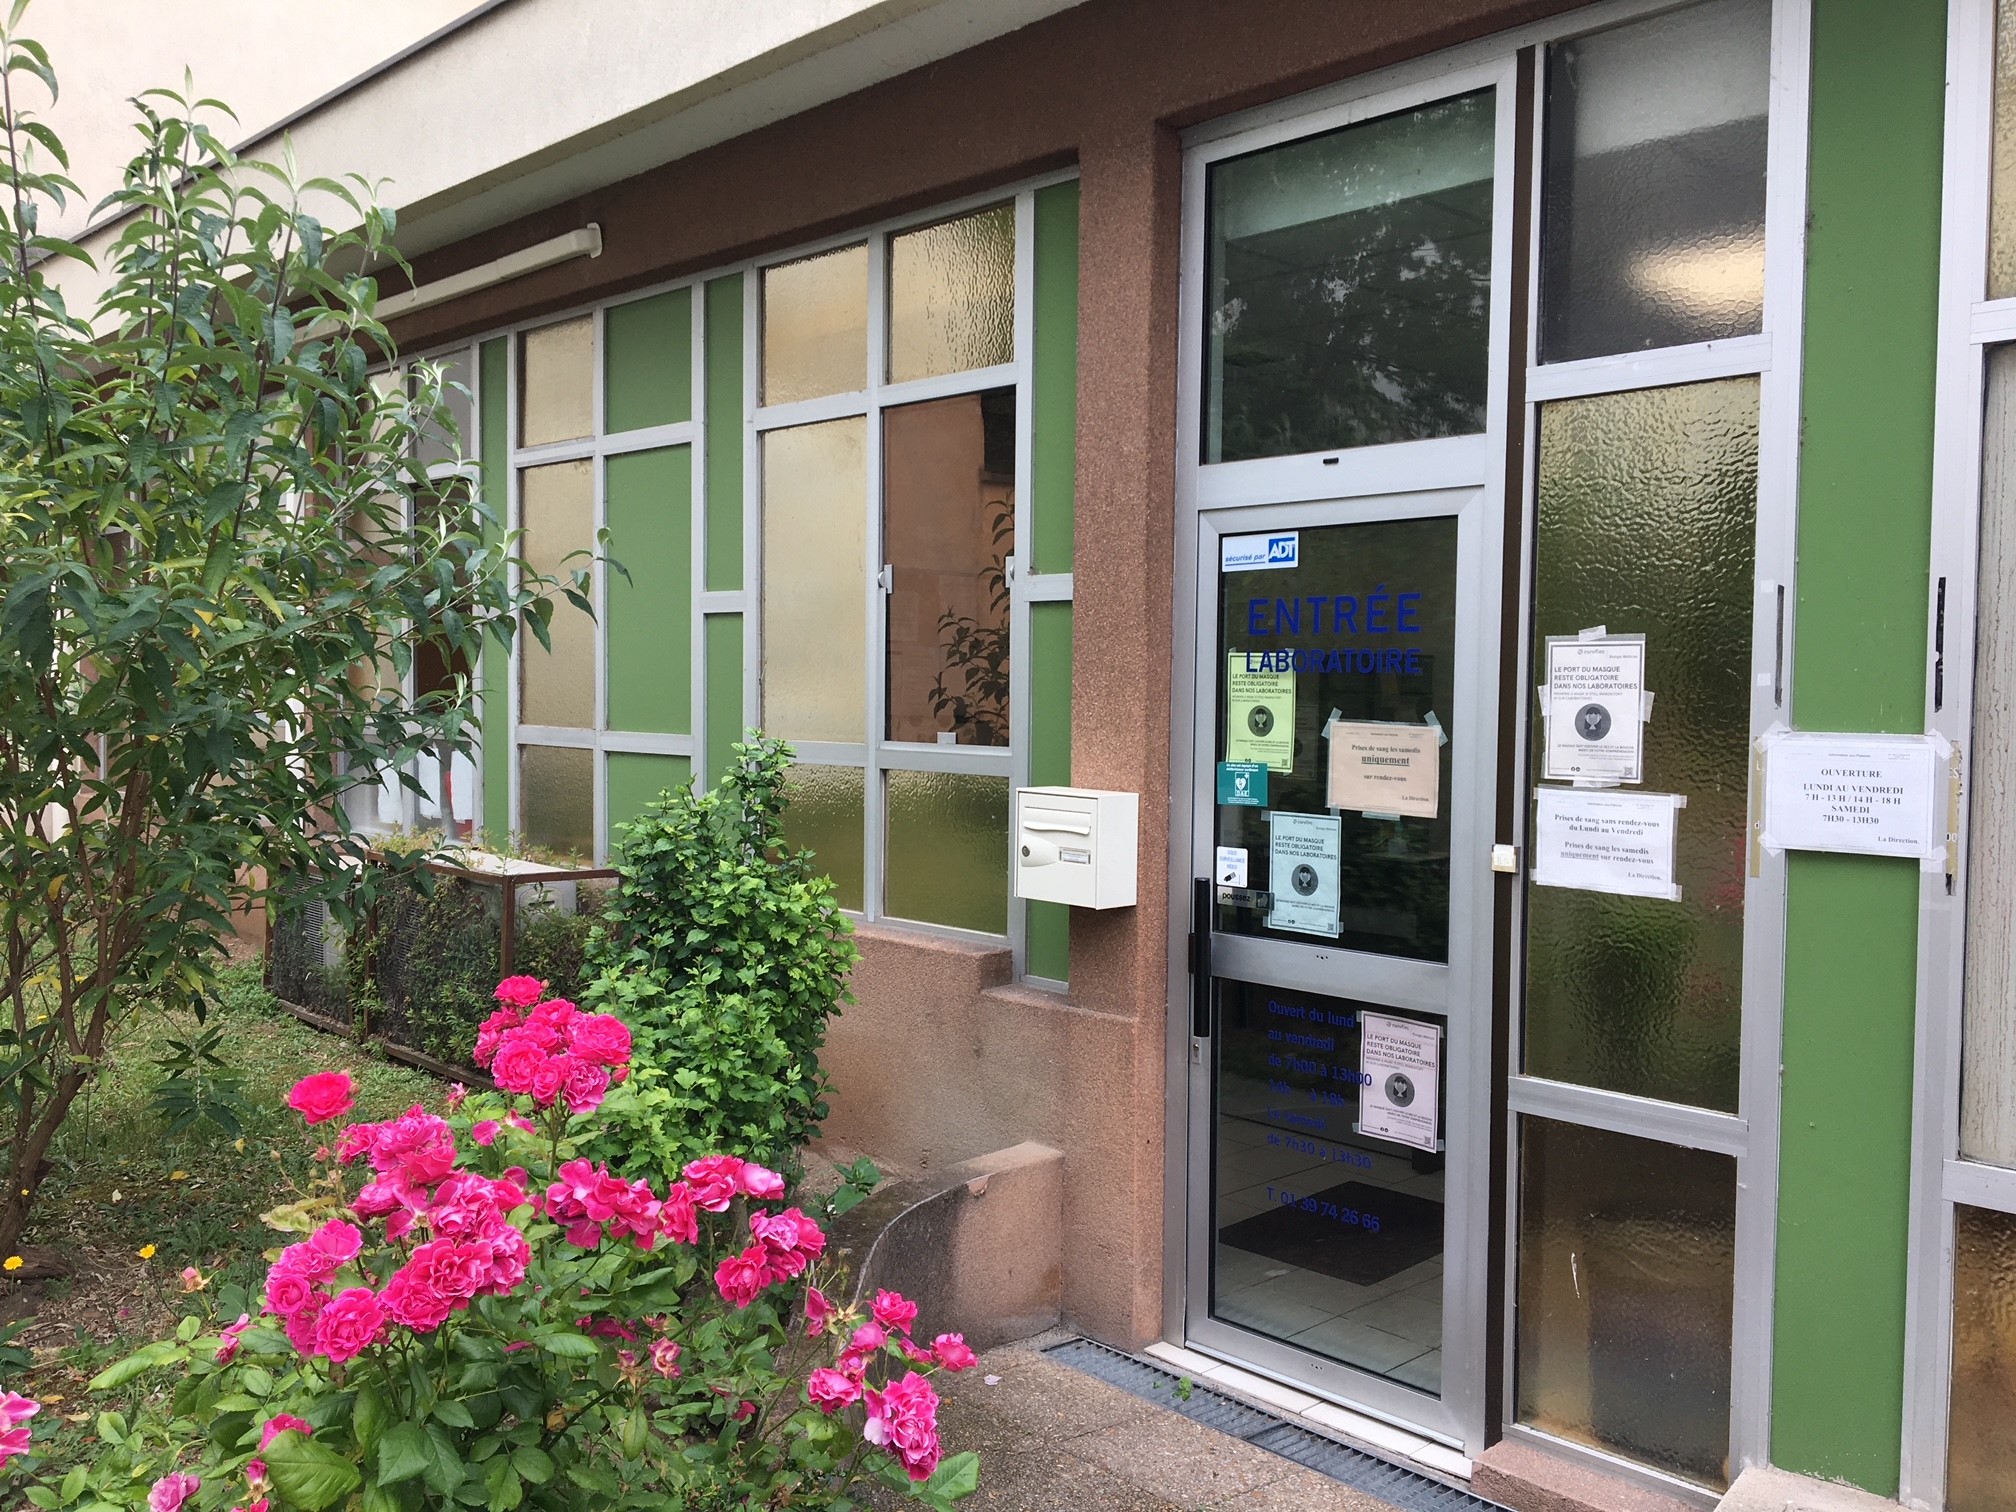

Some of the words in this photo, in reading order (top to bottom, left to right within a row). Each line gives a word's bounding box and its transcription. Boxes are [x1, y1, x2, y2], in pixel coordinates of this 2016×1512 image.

[1225, 553, 1252, 562] sécurisé
[1269, 540, 1296, 560] ADT
[1249, 583, 1422, 636] ENTRÉE
[1246, 648, 1422, 674] LABORATOIRE
[1361, 754, 1410, 765] uniquement
[1821, 768, 1882, 778] OUVERTURE
[1803, 783, 1833, 791] LUNDI
[1836, 784, 1848, 792] AU
[1851, 785, 1903, 794] VENDREDI
[1831, 805, 1870, 814] SAMEDI
[1618, 819, 1660, 828] rendez-vous
[1823, 814, 1844, 822] 7H30
[1852, 816, 1879, 824] 13H30
[1611, 827, 1644, 835] Vendredi
[1888, 836, 1920, 844] Direction.
[1291, 843, 1323, 851] OBLIGATOIRE
[1564, 841, 1583, 849] Prises
[1622, 846, 1649, 855] samedis
[1300, 852, 1336, 860] LABORATOIRES
[1560, 850, 1599, 859] uniquement
[1613, 855, 1654, 864] rendez-vous
[1222, 893, 1251, 902] poussez
[1268, 1000, 1305, 1019] Ouvert
[1309, 1008, 1324, 1020] du
[1268, 1029, 1282, 1040] au
[1286, 1032, 1335, 1051] vendredi
[1399, 1040, 1421, 1050] MASQUE
[1367, 1041, 1383, 1049] RESTE
[1385, 1044, 1420, 1057] OBLIGATOIRE
[1395, 1054, 1435, 1068] LABORATOIRES
[1268, 1053, 1281, 1066] de
[1286, 1055, 1317, 1073] 7h00
[1320, 1063, 1327, 1077] à
[1332, 1066, 1372, 1087] 13h00
[1268, 1134, 1280, 1146] de
[1285, 1136, 1315, 1155] 7h30
[1332, 1147, 1373, 1169] 13h30
[1281, 1191, 1296, 1208] 01
[1301, 1197, 1318, 1213] 39
[1321, 1202, 1338, 1219] 74
[1342, 1207, 1358, 1225] 26
[1362, 1214, 1380, 1232] 66
